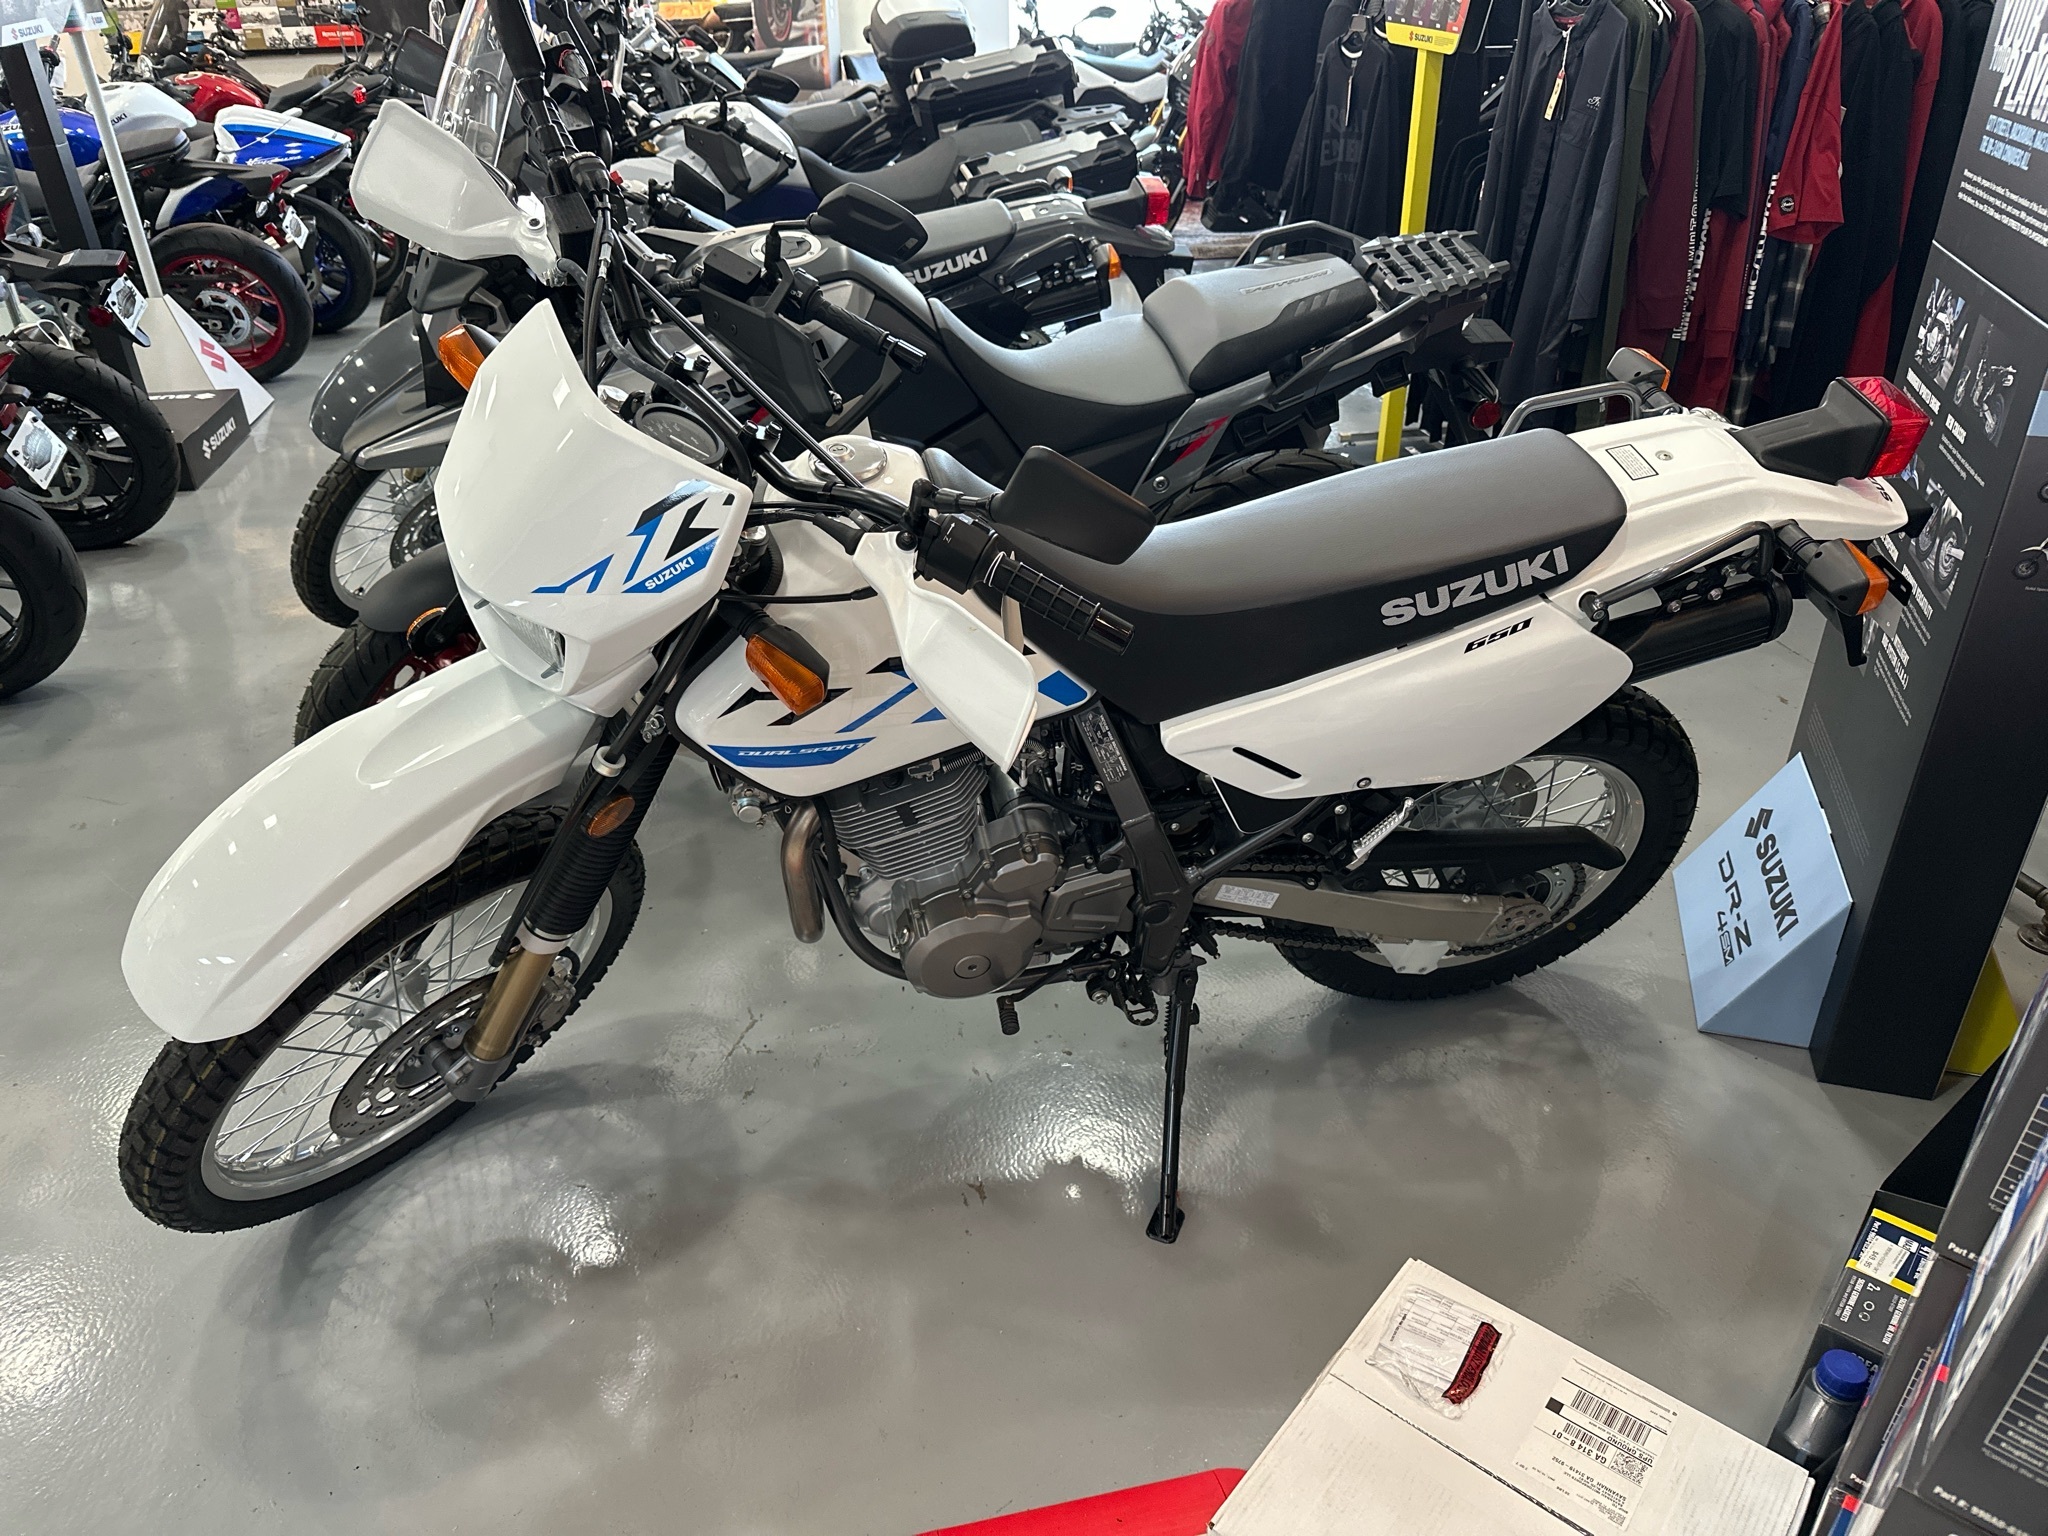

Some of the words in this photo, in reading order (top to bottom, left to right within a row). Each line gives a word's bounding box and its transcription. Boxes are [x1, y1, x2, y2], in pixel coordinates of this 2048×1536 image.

[18, 25, 43, 37] SUZUKI
[1414, 33, 1433, 43] SUZUKI
[208, 416, 237, 451] SUZUKI
[645, 556, 695, 591] SUZUKI
[1380, 545, 1569, 627] SUZUKI
[1464, 617, 1533, 654] 650
[1756, 834, 1799, 939] SUZUKI
[1718, 850, 1752, 956] DR-Z
[1862, 1248, 1878, 1269] $49.95
[1947, 1241, 1968, 1257] Part
[1576, 1443, 1592, 1456] 314
[1606, 1435, 1636, 1455] GROUND
[1593, 1452, 1607, 1464] GA
[1637, 1452, 1653, 1464] UPS
[1596, 1481, 1626, 1501] SAVANNAH
[1600, 1492, 1623, 1507] SAVANNAH
[1932, 1484, 1958, 1504] Part
